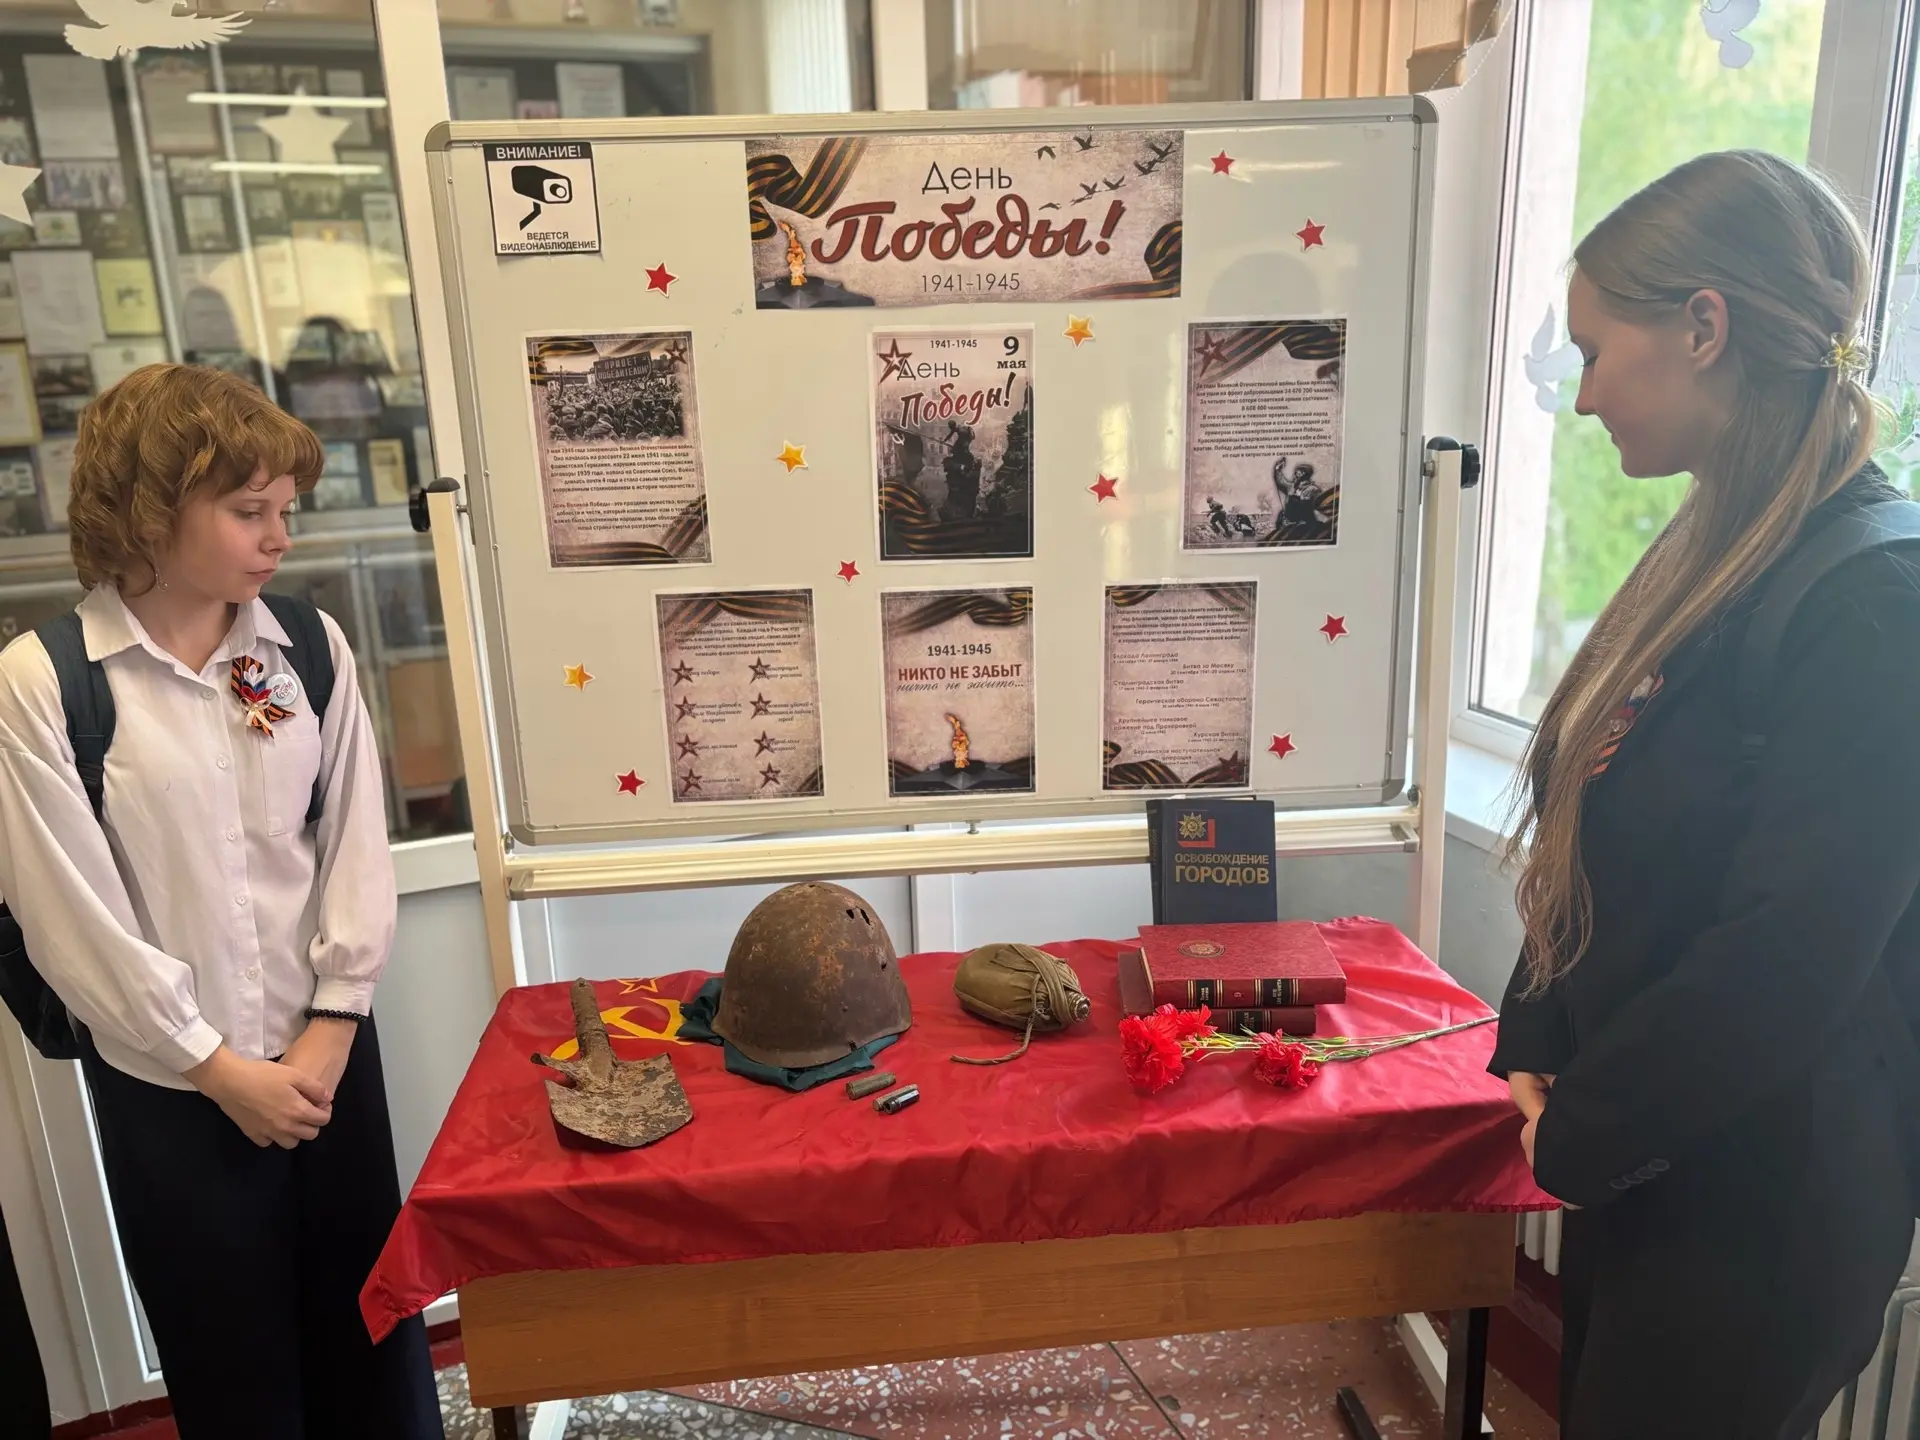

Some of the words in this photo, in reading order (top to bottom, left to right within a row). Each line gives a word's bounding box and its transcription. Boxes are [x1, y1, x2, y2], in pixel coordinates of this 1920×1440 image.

[496, 146, 581, 159] ВНИМАНИЕ!
[921, 161, 1012, 195] День
[527, 232, 569, 241] ВЕДЕТСЯ
[811, 194, 1126, 264] Победы!
[501, 241, 596, 252] ВИДЕОНАБЛЮДЕНИЕ
[921, 273, 1020, 292] 1941-1945
[931, 340, 977, 348] 1941-1945
[1003, 336, 1019, 355] 9
[897, 359, 960, 380] День
[997, 360, 1026, 369] мая
[900, 372, 1016, 428] Победы!
[928, 643, 992, 656] 1941-1945
[898, 666, 945, 681] НИКТО
[950, 666, 969, 679] НЕ
[972, 664, 1023, 678] ЗАБЫТ
[945, 681, 960, 690] не
[1175, 853, 1269, 865] ОСВОБОЖДЕНИЕ
[1175, 865, 1269, 886] ГОРОДОВ
